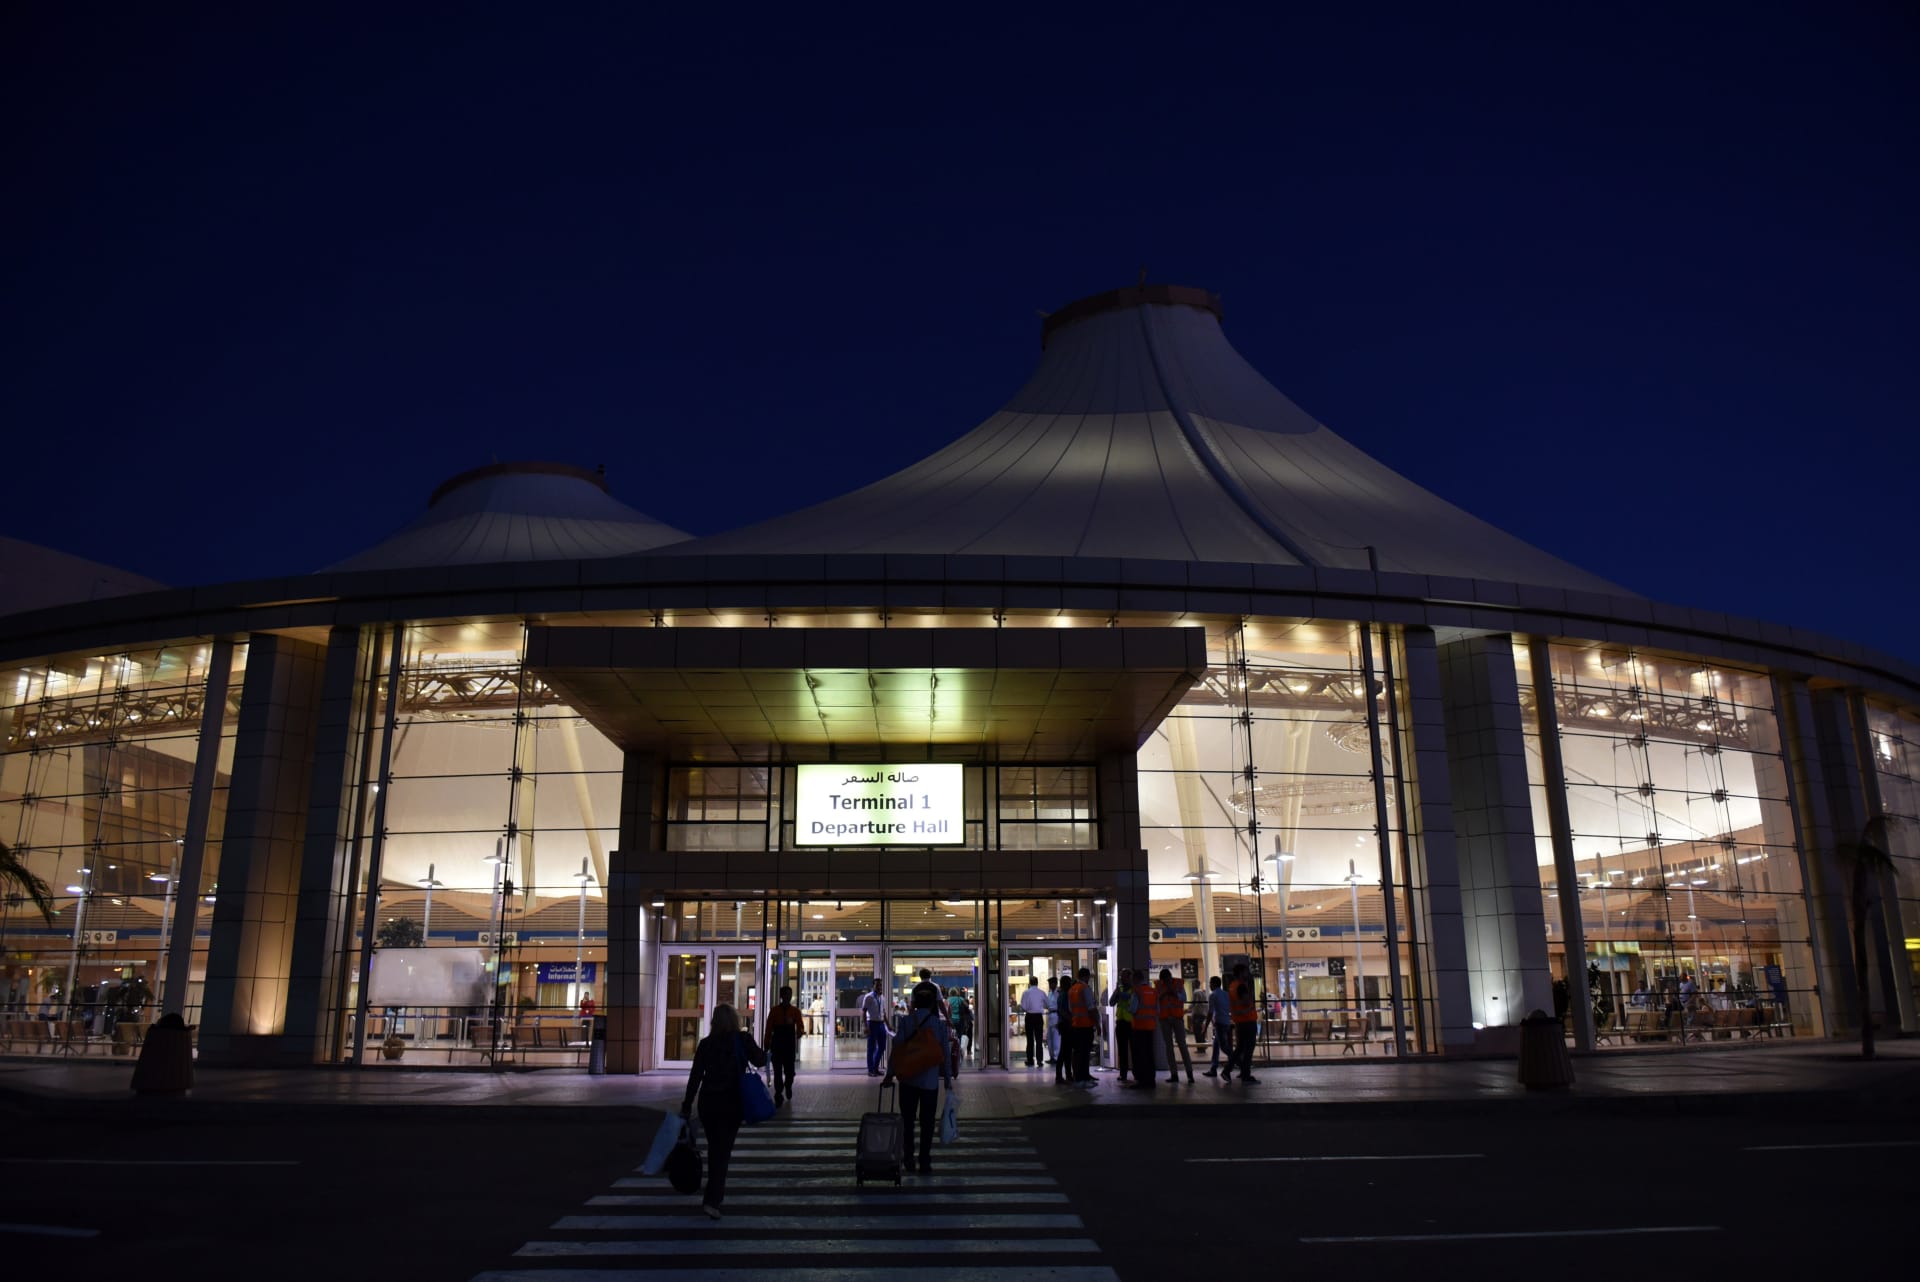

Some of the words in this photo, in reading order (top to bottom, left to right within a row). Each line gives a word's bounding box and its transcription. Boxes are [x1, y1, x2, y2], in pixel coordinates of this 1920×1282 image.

[829, 793, 914, 810] Terminal
[921, 794, 932, 809] 1
[811, 820, 906, 837] Departure
[913, 820, 948, 834] Hall
